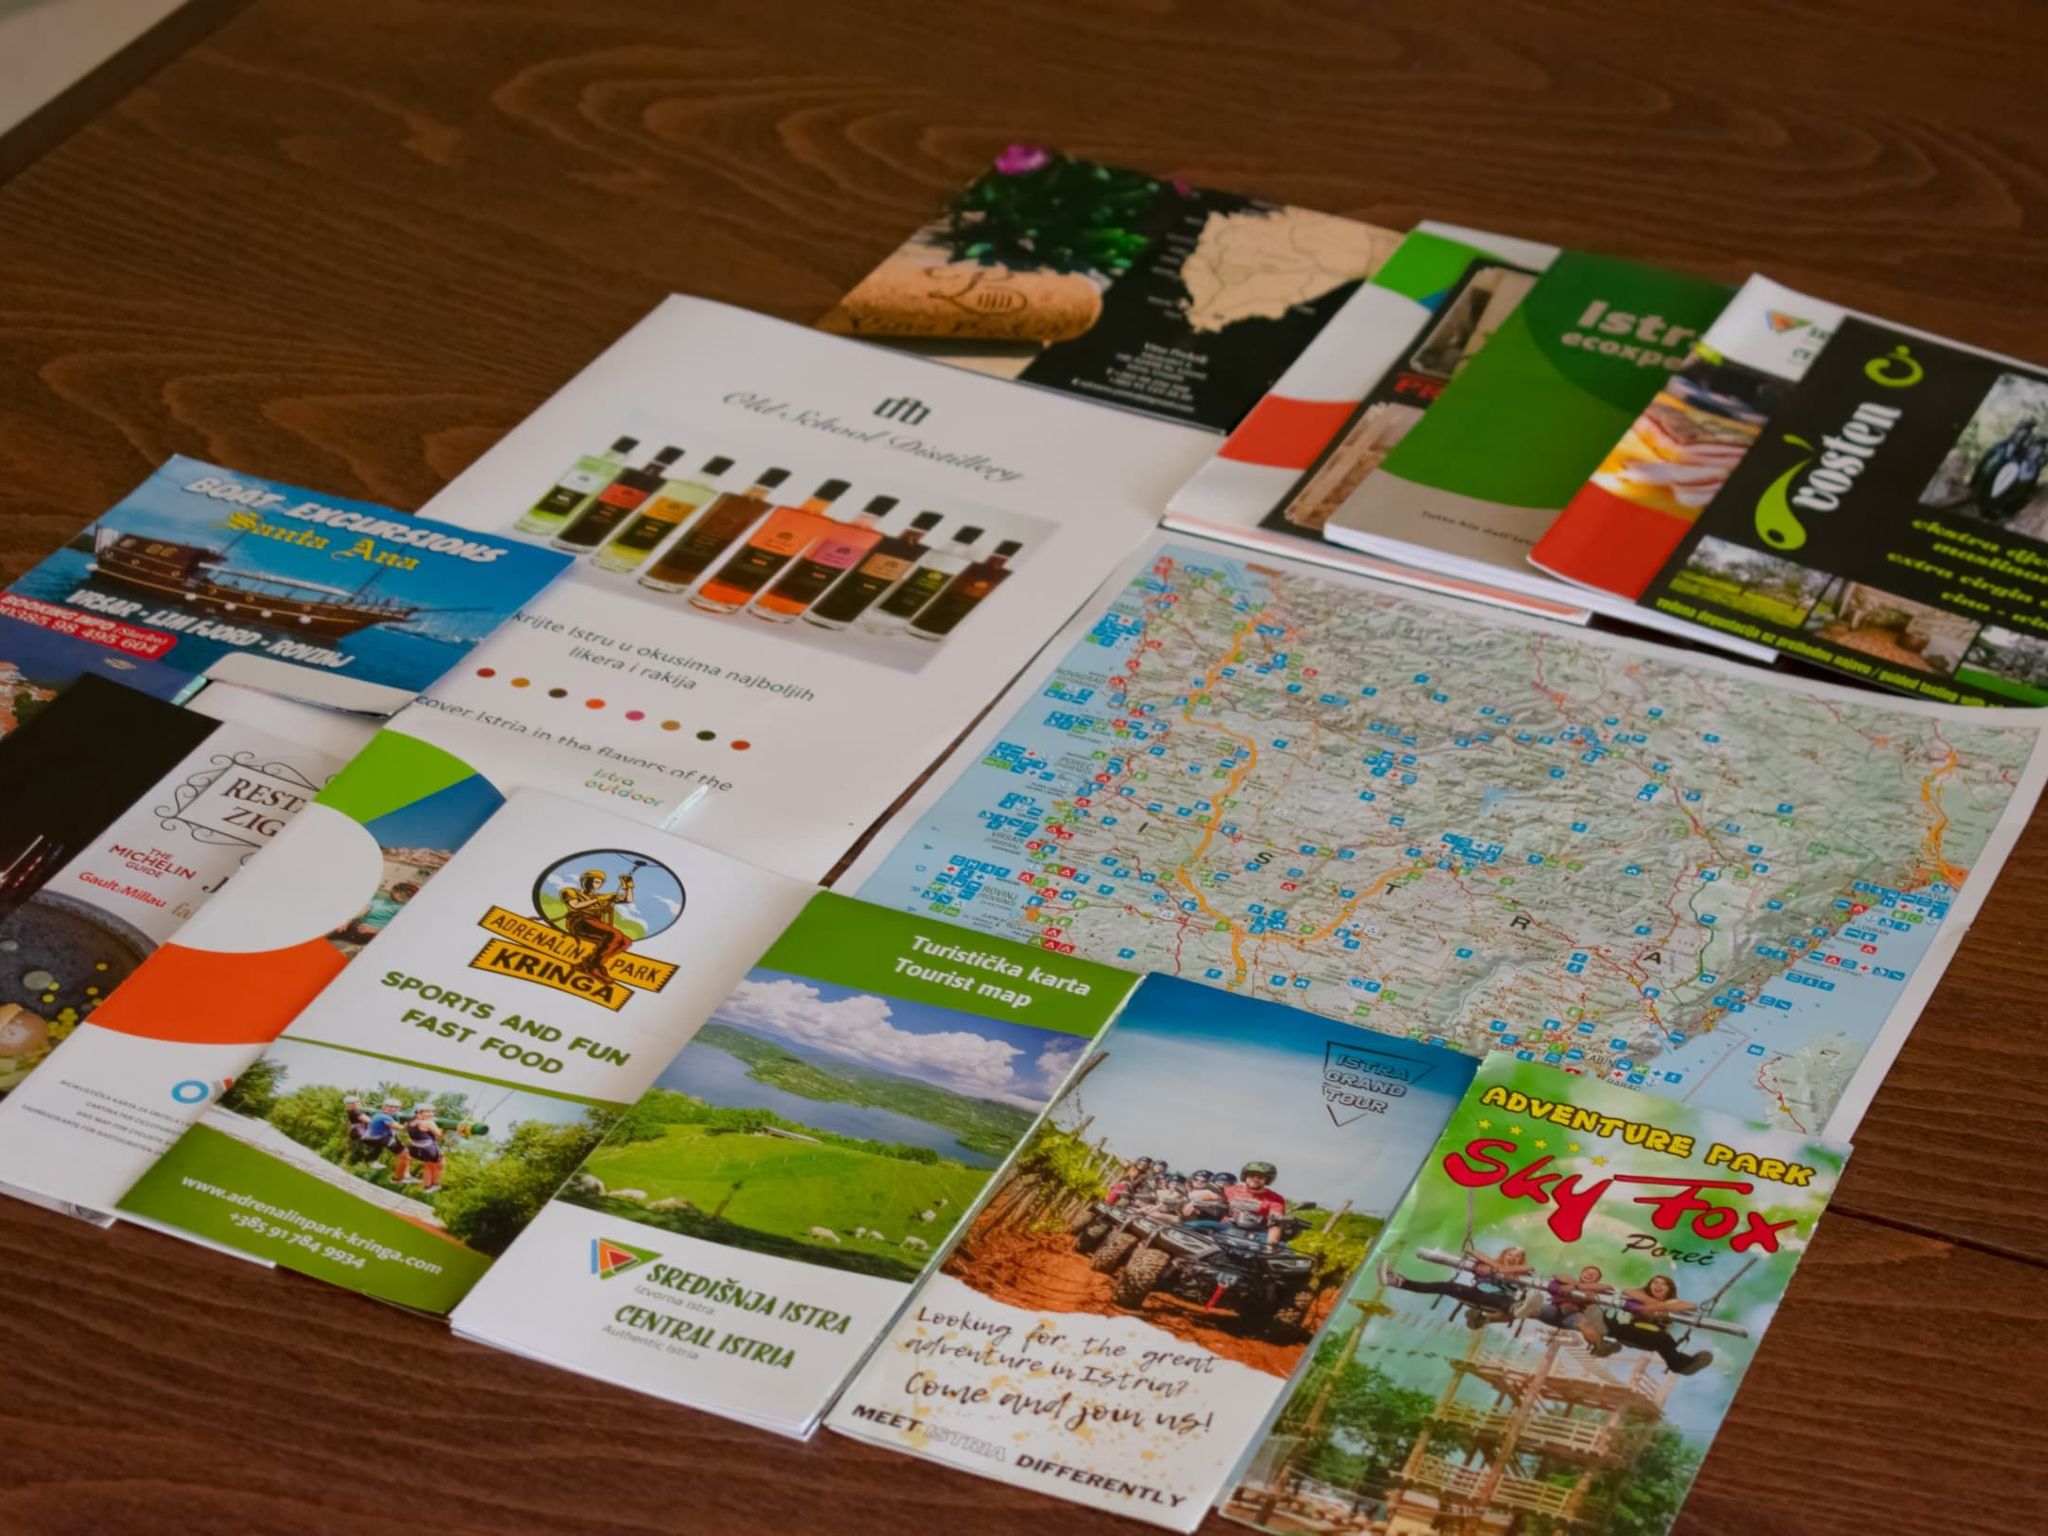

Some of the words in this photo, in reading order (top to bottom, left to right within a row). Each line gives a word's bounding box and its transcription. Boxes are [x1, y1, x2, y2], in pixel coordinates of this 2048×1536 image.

[1577, 298, 1698, 347] Istr
[782, 409, 888, 442] School
[888, 434, 1024, 482] Distillery
[182, 476, 285, 508] BOAT
[284, 501, 509, 562] EXCURSIONS
[227, 510, 330, 550] Santa
[331, 537, 420, 571] Ana
[65, 588, 143, 619] VRSAR
[267, 639, 356, 668] ROVINJ
[80, 628, 118, 644] 495
[120, 637, 160, 654] 604
[568, 625, 615, 648] Istru
[618, 641, 633, 653] u
[636, 645, 722, 677] okusima
[725, 669, 815, 703] najboljih
[568, 645, 625, 671] likera
[628, 662, 637, 673] i
[639, 663, 697, 691] rakija
[476, 710, 529, 735] Istria
[531, 726, 552, 742] in
[557, 731, 592, 752] the
[697, 772, 733, 792] the
[108, 844, 198, 881] MICHELIN
[125, 860, 165, 879] GUIDE
[149, 848, 174, 860] THE
[491, 947, 617, 1005] KRINGA
[492, 914, 584, 960] ADRENALIN
[610, 957, 663, 984] PARK
[911, 934, 1024, 978] Turistička
[1026, 966, 1092, 997] karta
[893, 956, 976, 992] Tourist
[976, 982, 1033, 1010] map
[381, 970, 496, 1020] SPORTS
[499, 1014, 563, 1043] AND
[567, 1036, 632, 1068] FUN
[400, 1008, 477, 1043] FAST
[479, 1036, 565, 1075] FOOD
[1324, 1069, 1408, 1097] GRAND
[1336, 1054, 1410, 1081] ISTRA
[1326, 1088, 1389, 1114] TOUR
[1479, 1085, 1696, 1159] ADVENTURE
[1704, 1142, 1816, 1188] PARK
[181, 1174, 443, 1275] www.adrenalinpark-kringa.com
[229, 1211, 266, 1235] +385
[266, 1224, 288, 1241] 91
[287, 1230, 321, 1254] 784
[324, 1244, 367, 1270] 9934
[1621, 1233, 1717, 1266] Poreč
[634, 1284, 684, 1306] Izvorna
[646, 1262, 778, 1317] SREDIŠNJA
[779, 1300, 852, 1335] ISTRA
[601, 1324, 664, 1351] Authentic
[614, 1303, 716, 1349] CENTRAL
[717, 1333, 796, 1369] ISTRIA
[904, 1332, 1045, 1373] adventure
[1050, 1360, 1076, 1380] in
[1078, 1366, 1189, 1398] Istria?
[918, 1305, 1013, 1343] Looking
[1021, 1323, 1067, 1353] for
[1081, 1334, 1127, 1358] the
[1142, 1347, 1222, 1374] great
[904, 1371, 990, 1406] Come
[999, 1389, 1073, 1424] and
[1064, 1401, 1143, 1432] join
[1155, 1409, 1215, 1434] us!
[851, 1403, 924, 1433] MEET
[923, 1422, 1008, 1462] ISTRIA
[1014, 1452, 1188, 1509] DIFFERENTLY
